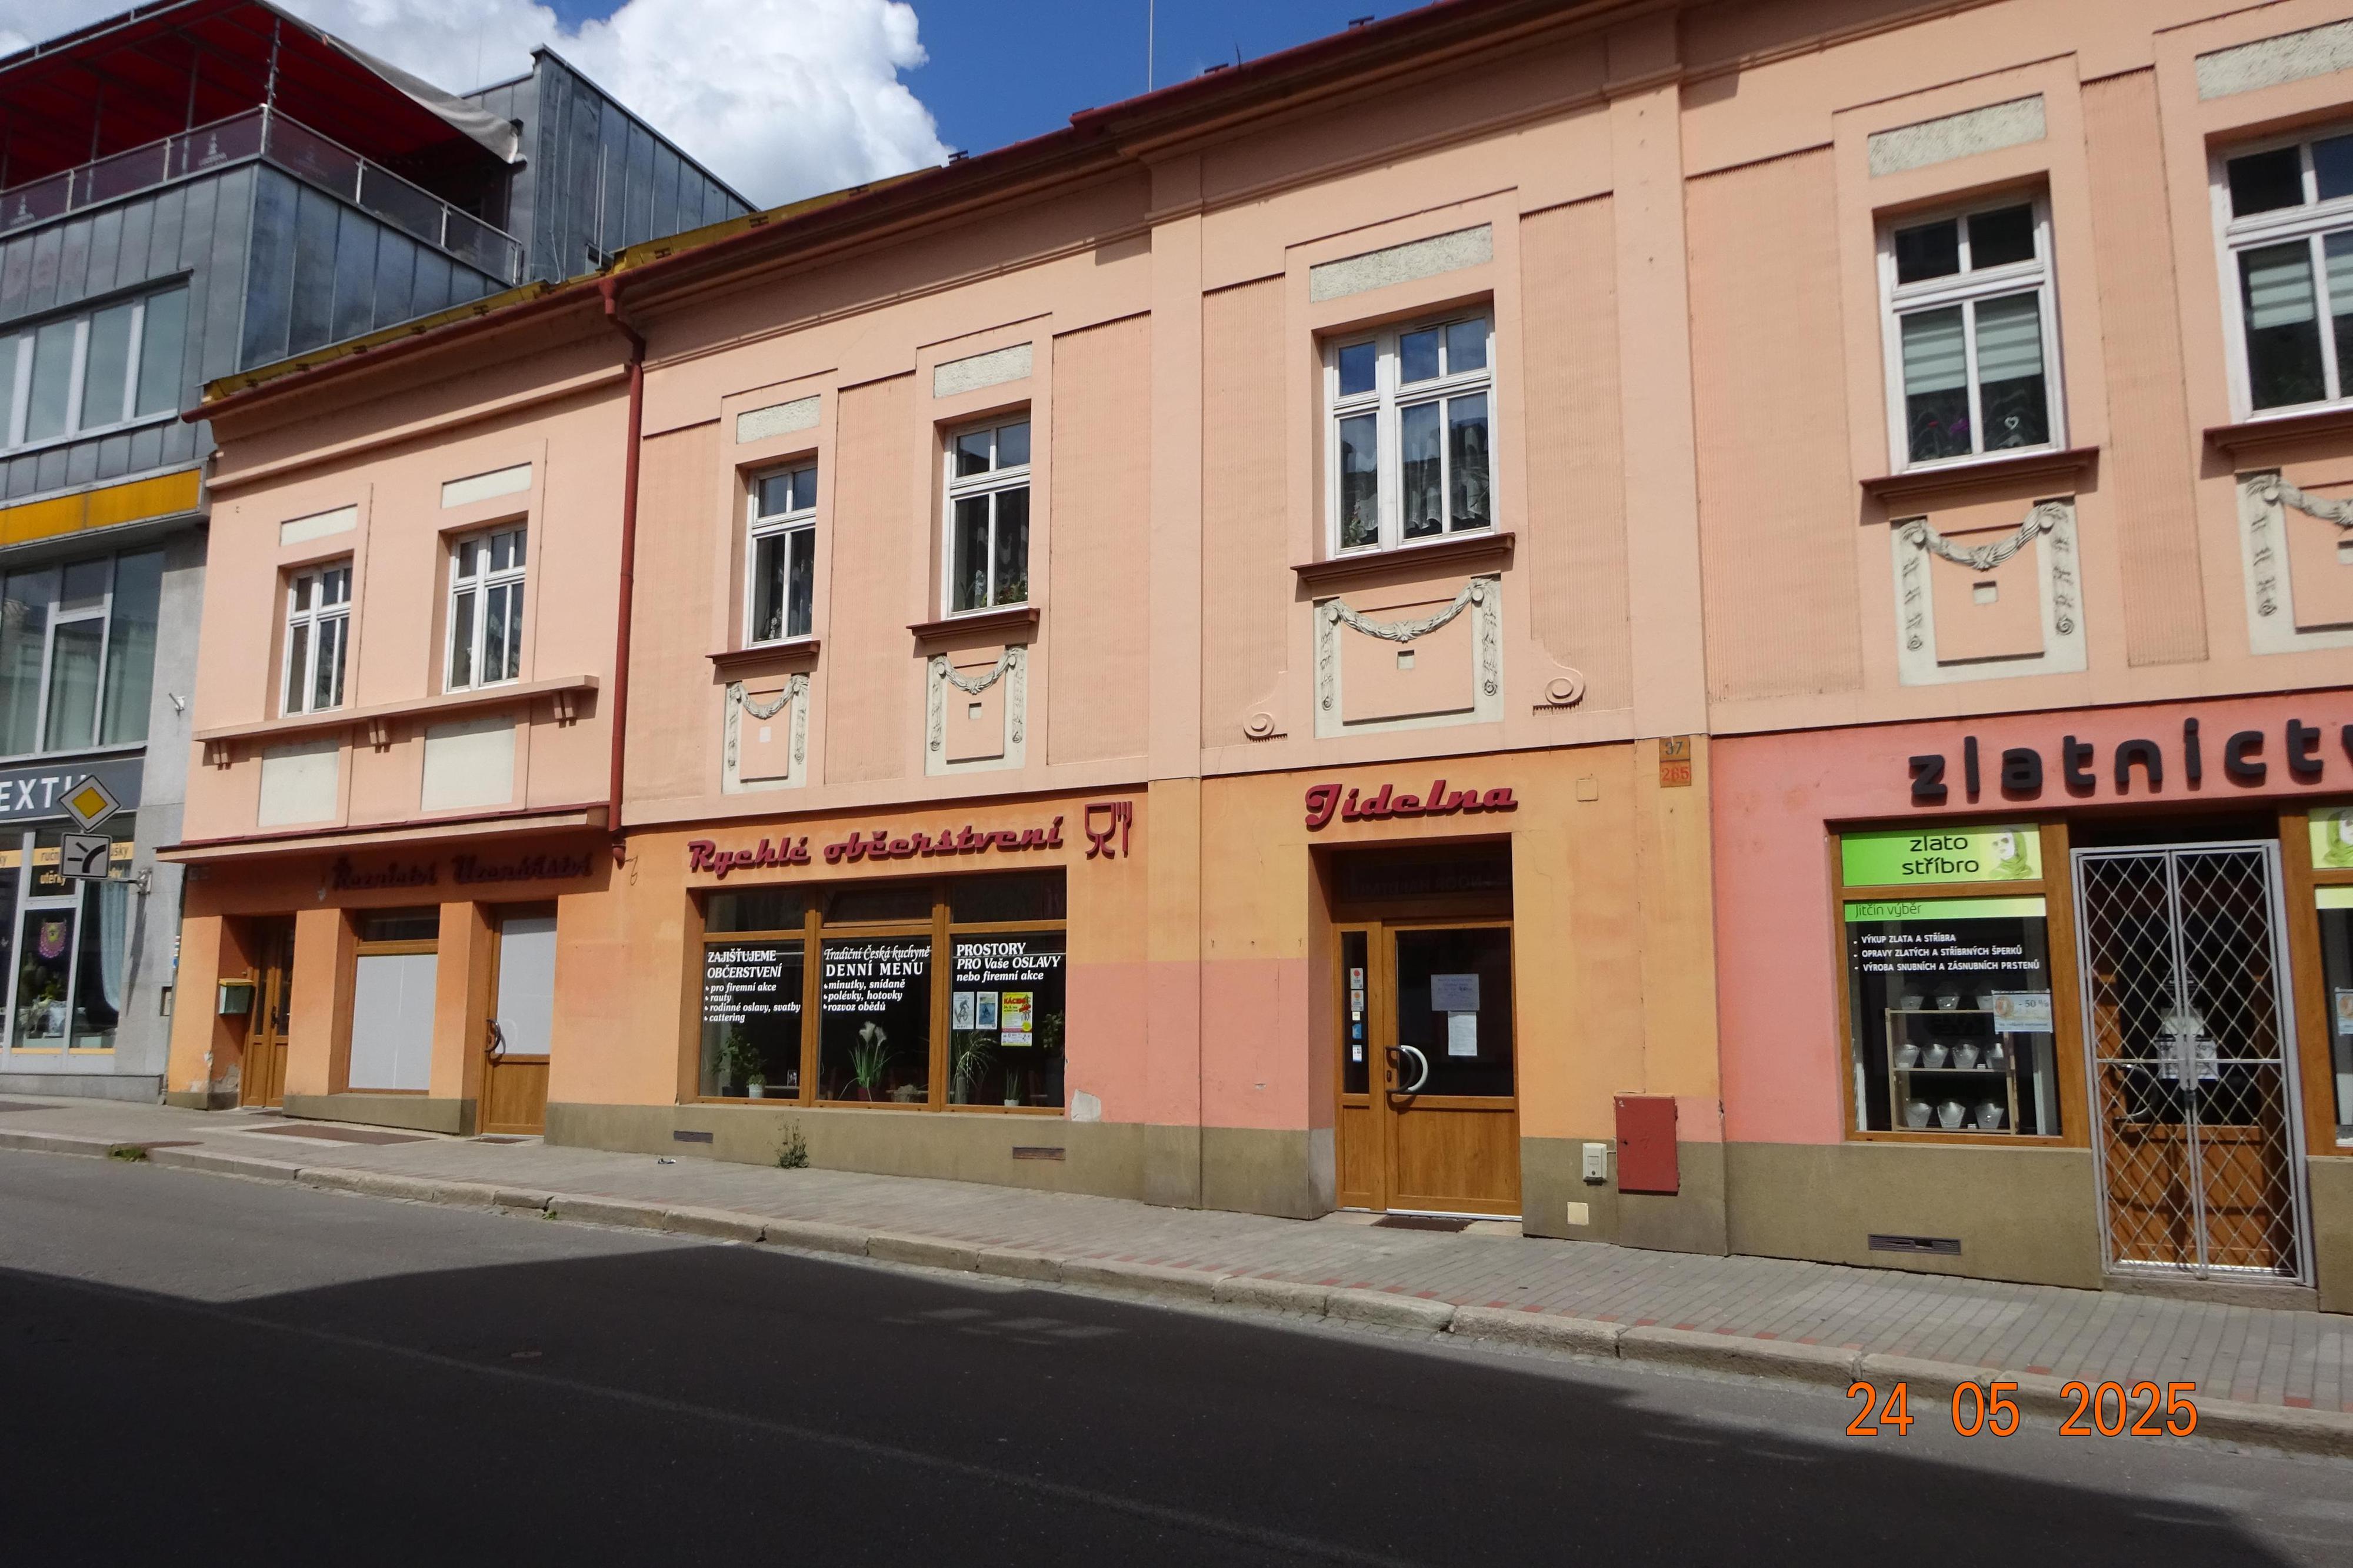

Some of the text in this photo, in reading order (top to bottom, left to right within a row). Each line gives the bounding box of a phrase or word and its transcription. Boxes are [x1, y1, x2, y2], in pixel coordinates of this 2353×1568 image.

[1665, 741, 1683, 755] 37
[1909, 717, 2353, 799] zlatnict
[1661, 766, 1689, 782] 265
[1305, 779, 1518, 829] Jídelna
[687, 816, 1064, 880] Rychlé občerstvení
[1909, 836, 1968, 852] zlato
[1902, 858, 1979, 875] stříbro
[1887, 902, 1922, 918] výběr
[1861, 934, 1887, 943] VÝKUP
[1924, 932, 1956, 942] STŘÍBRA
[708, 948, 776, 962] ZAJIŠŤUJEME
[824, 945, 931, 962] Tradiční Česká kuchyně
[956, 942, 1026, 956] PROSTORY
[1895, 947, 1929, 957] ZLATÝCH
[1941, 945, 1989, 956] STŘÍBRNÝCH
[1992, 945, 2022, 955] ŠPERKŮ
[826, 960, 923, 976] DENNÍ MENU
[956, 956, 1061, 969] PRO Vaše OSLAVY
[1863, 962, 1894, 971] VÝROBA
[1897, 961, 1936, 970] SNUBNÍCH
[1948, 960, 1998, 970] ZÁSNUBNÍCH
[2001, 959, 2039, 969] PRSTENŮ
[707, 963, 782, 978] OBČERSTVENÍ
[956, 970, 1044, 983] nebo firemní akce
[710, 982, 776, 993] pro firemní akce
[828, 979, 905, 990] minutky, snídaně
[710, 994, 732, 1003] rauty
[828, 990, 902, 1002] polévky, hotovky
[709, 1002, 801, 1013] rodinné oslavy, svatby
[828, 1001, 886, 1011] rozvoz obědů
[709, 1013, 745, 1023] cattering
